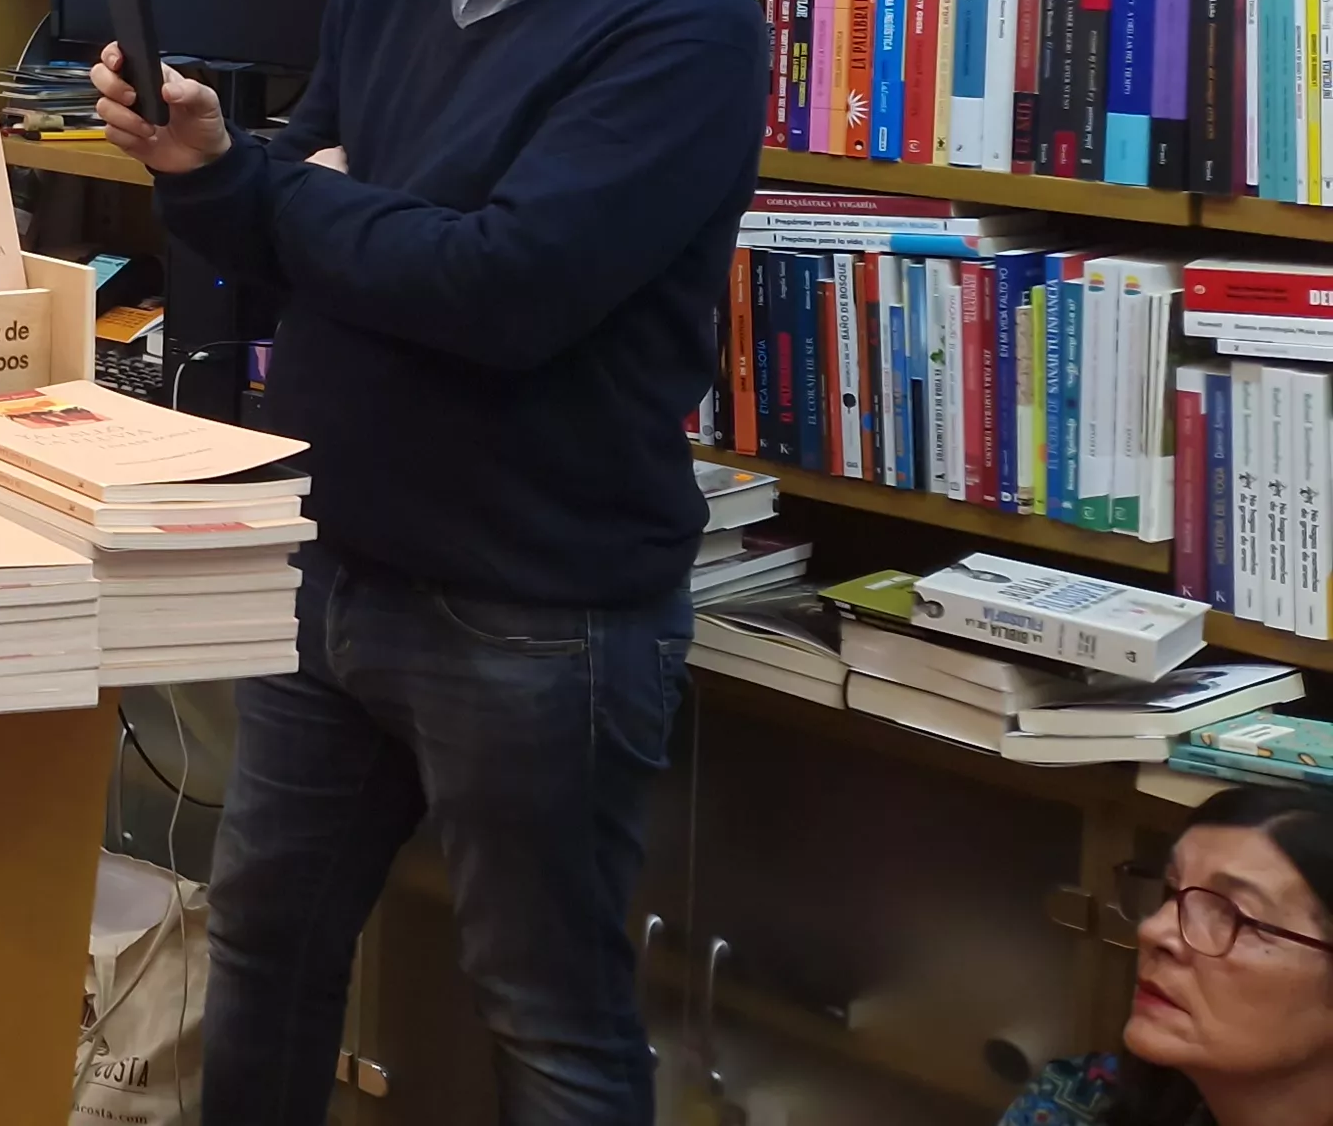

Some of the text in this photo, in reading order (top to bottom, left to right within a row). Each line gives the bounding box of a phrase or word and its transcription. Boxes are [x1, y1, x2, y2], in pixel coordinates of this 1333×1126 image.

[853, 6, 869, 54] PALABRA
[915, 11, 924, 34] PEDRO
[852, 56, 867, 70] LA
[775, 218, 813, 227] Prepárate
[814, 219, 831, 228] para
[781, 235, 817, 244] Prepárate
[818, 237, 835, 245] para
[838, 262, 851, 340] BAÑO DE BOSQUE
[999, 267, 1009, 357] EN MI VIDA FALTO YO
[4, 322, 30, 342] de
[805, 337, 817, 425] EL CORAJE DE SER
[1249, 494, 1257, 507] No
[1279, 503, 1287, 515] No
[1246, 509, 1257, 533] hagas
[1311, 509, 1319, 522] No
[1277, 517, 1287, 542] hagas
[1308, 524, 1319, 549] hagas
[990, 626, 1030, 644] BIBLIA
